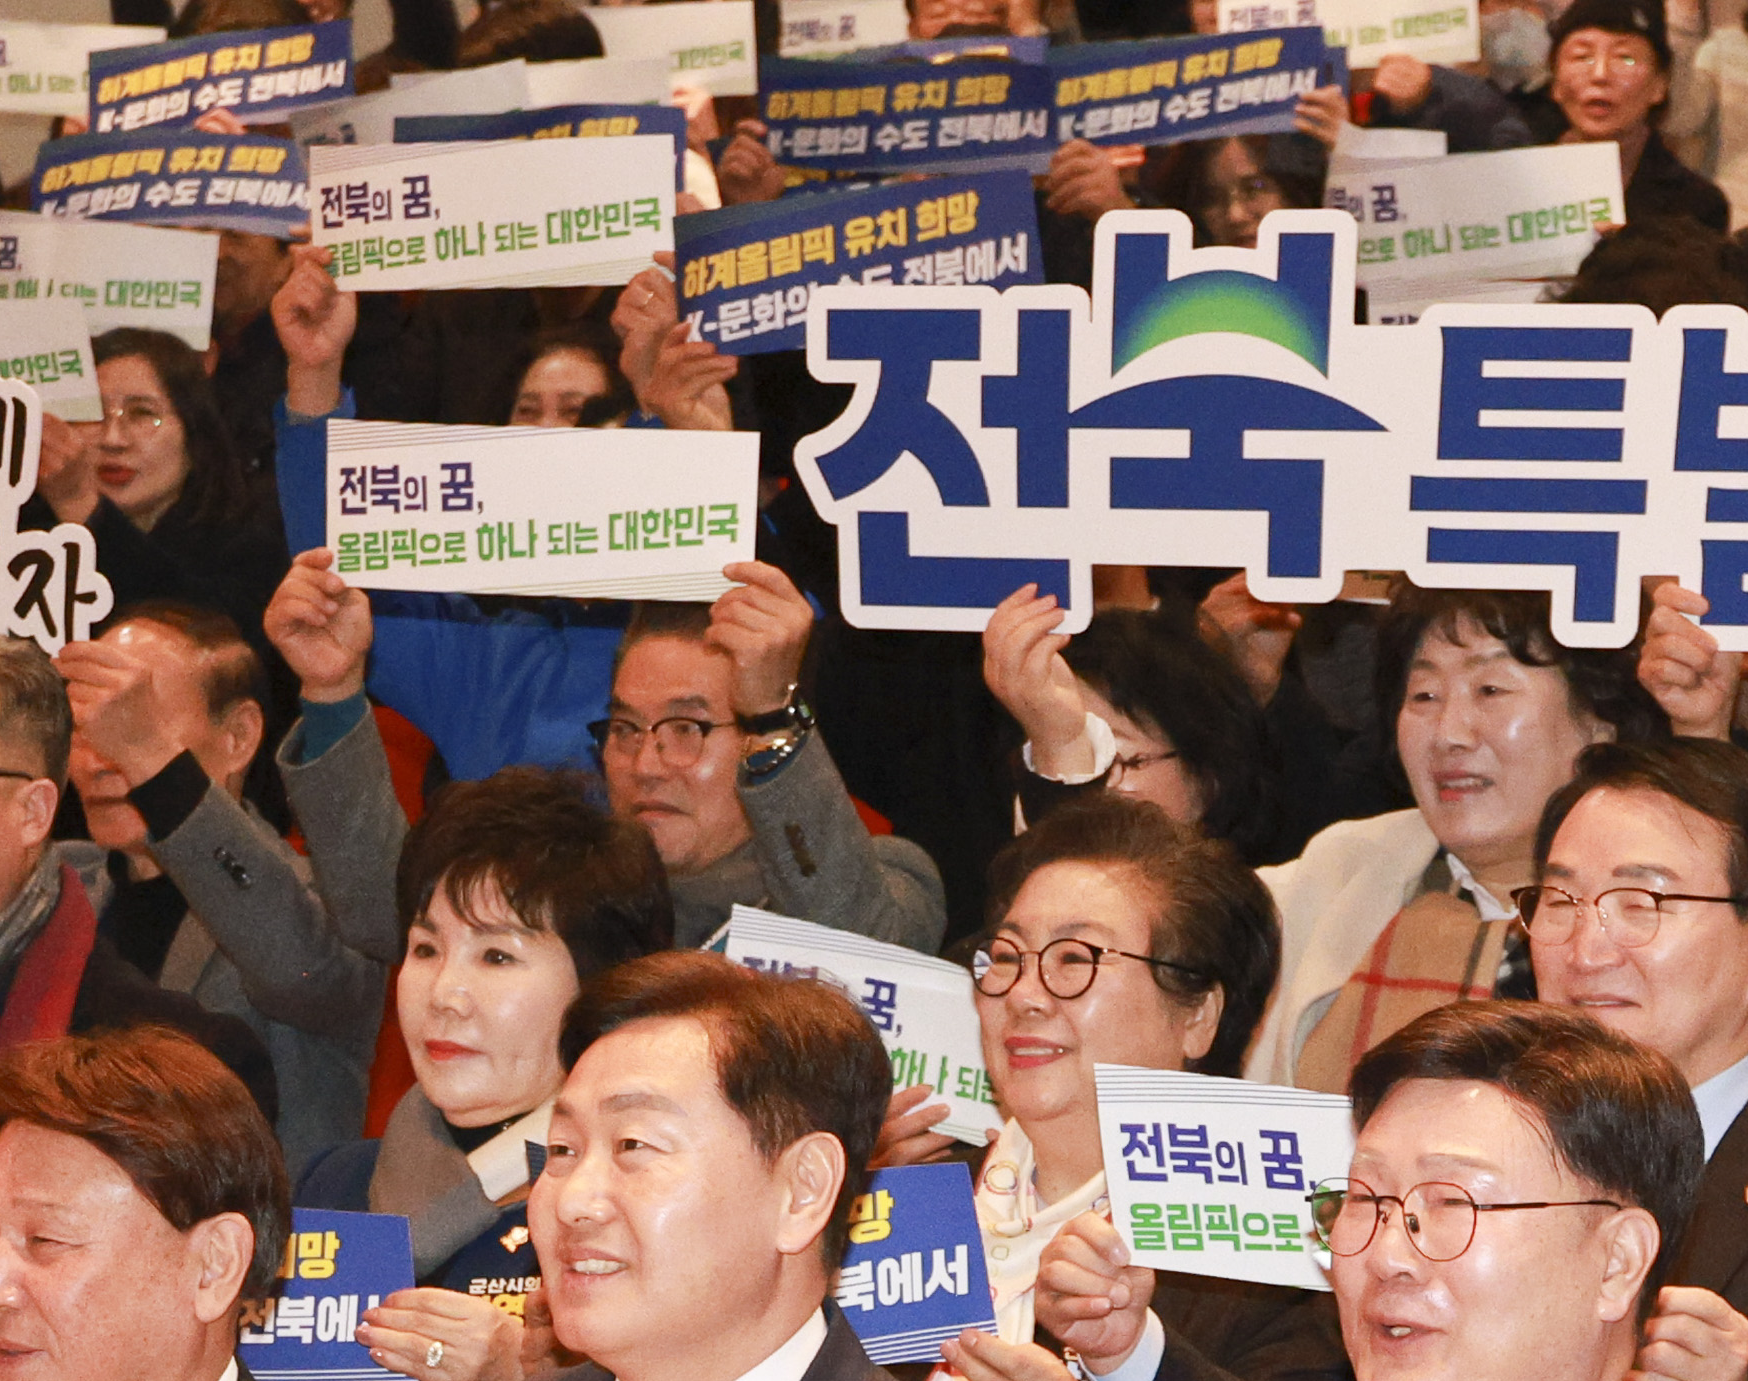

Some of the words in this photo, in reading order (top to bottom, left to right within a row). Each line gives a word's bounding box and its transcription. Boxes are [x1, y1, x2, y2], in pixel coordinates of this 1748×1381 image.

[194, 77, 245, 112] 수도
[892, 79, 949, 114] 유치
[1163, 87, 1212, 122] 수도
[874, 119, 930, 154] 수도
[936, 107, 1050, 148] 전북에서
[144, 179, 200, 209] 수도
[319, 180, 392, 230] 전북의
[401, 174, 441, 221] 꿈,
[323, 234, 427, 279] 올림픽으로
[433, 220, 487, 263] 하나
[493, 220, 540, 253] 되는
[545, 196, 662, 245] 대한민국
[682, 222, 836, 299] 하계올림픽
[843, 207, 908, 258] 유치
[914, 189, 981, 243] 희망
[1402, 224, 1452, 260] 하나
[1506, 196, 1611, 244] 대한민국
[901, 231, 1030, 286] 전북에서
[104, 278, 202, 308] 대한민국
[338, 464, 428, 516] 전북의
[439, 461, 484, 515] 꿈,
[336, 527, 467, 573] 올림픽으로
[475, 518, 539, 562] 하나
[546, 520, 598, 556] 되는
[607, 502, 740, 552] 대한민국
[861, 975, 904, 1037] 꿈,
[890, 1047, 950, 1096] 하나
[1119, 1121, 1250, 1187] 전북의
[1258, 1128, 1317, 1193] 꿈,
[845, 1188, 896, 1245] 망
[1129, 1201, 1305, 1253] 올림픽으로
[468, 1275, 542, 1295] 군산시의
[835, 1243, 970, 1314] 북에서
